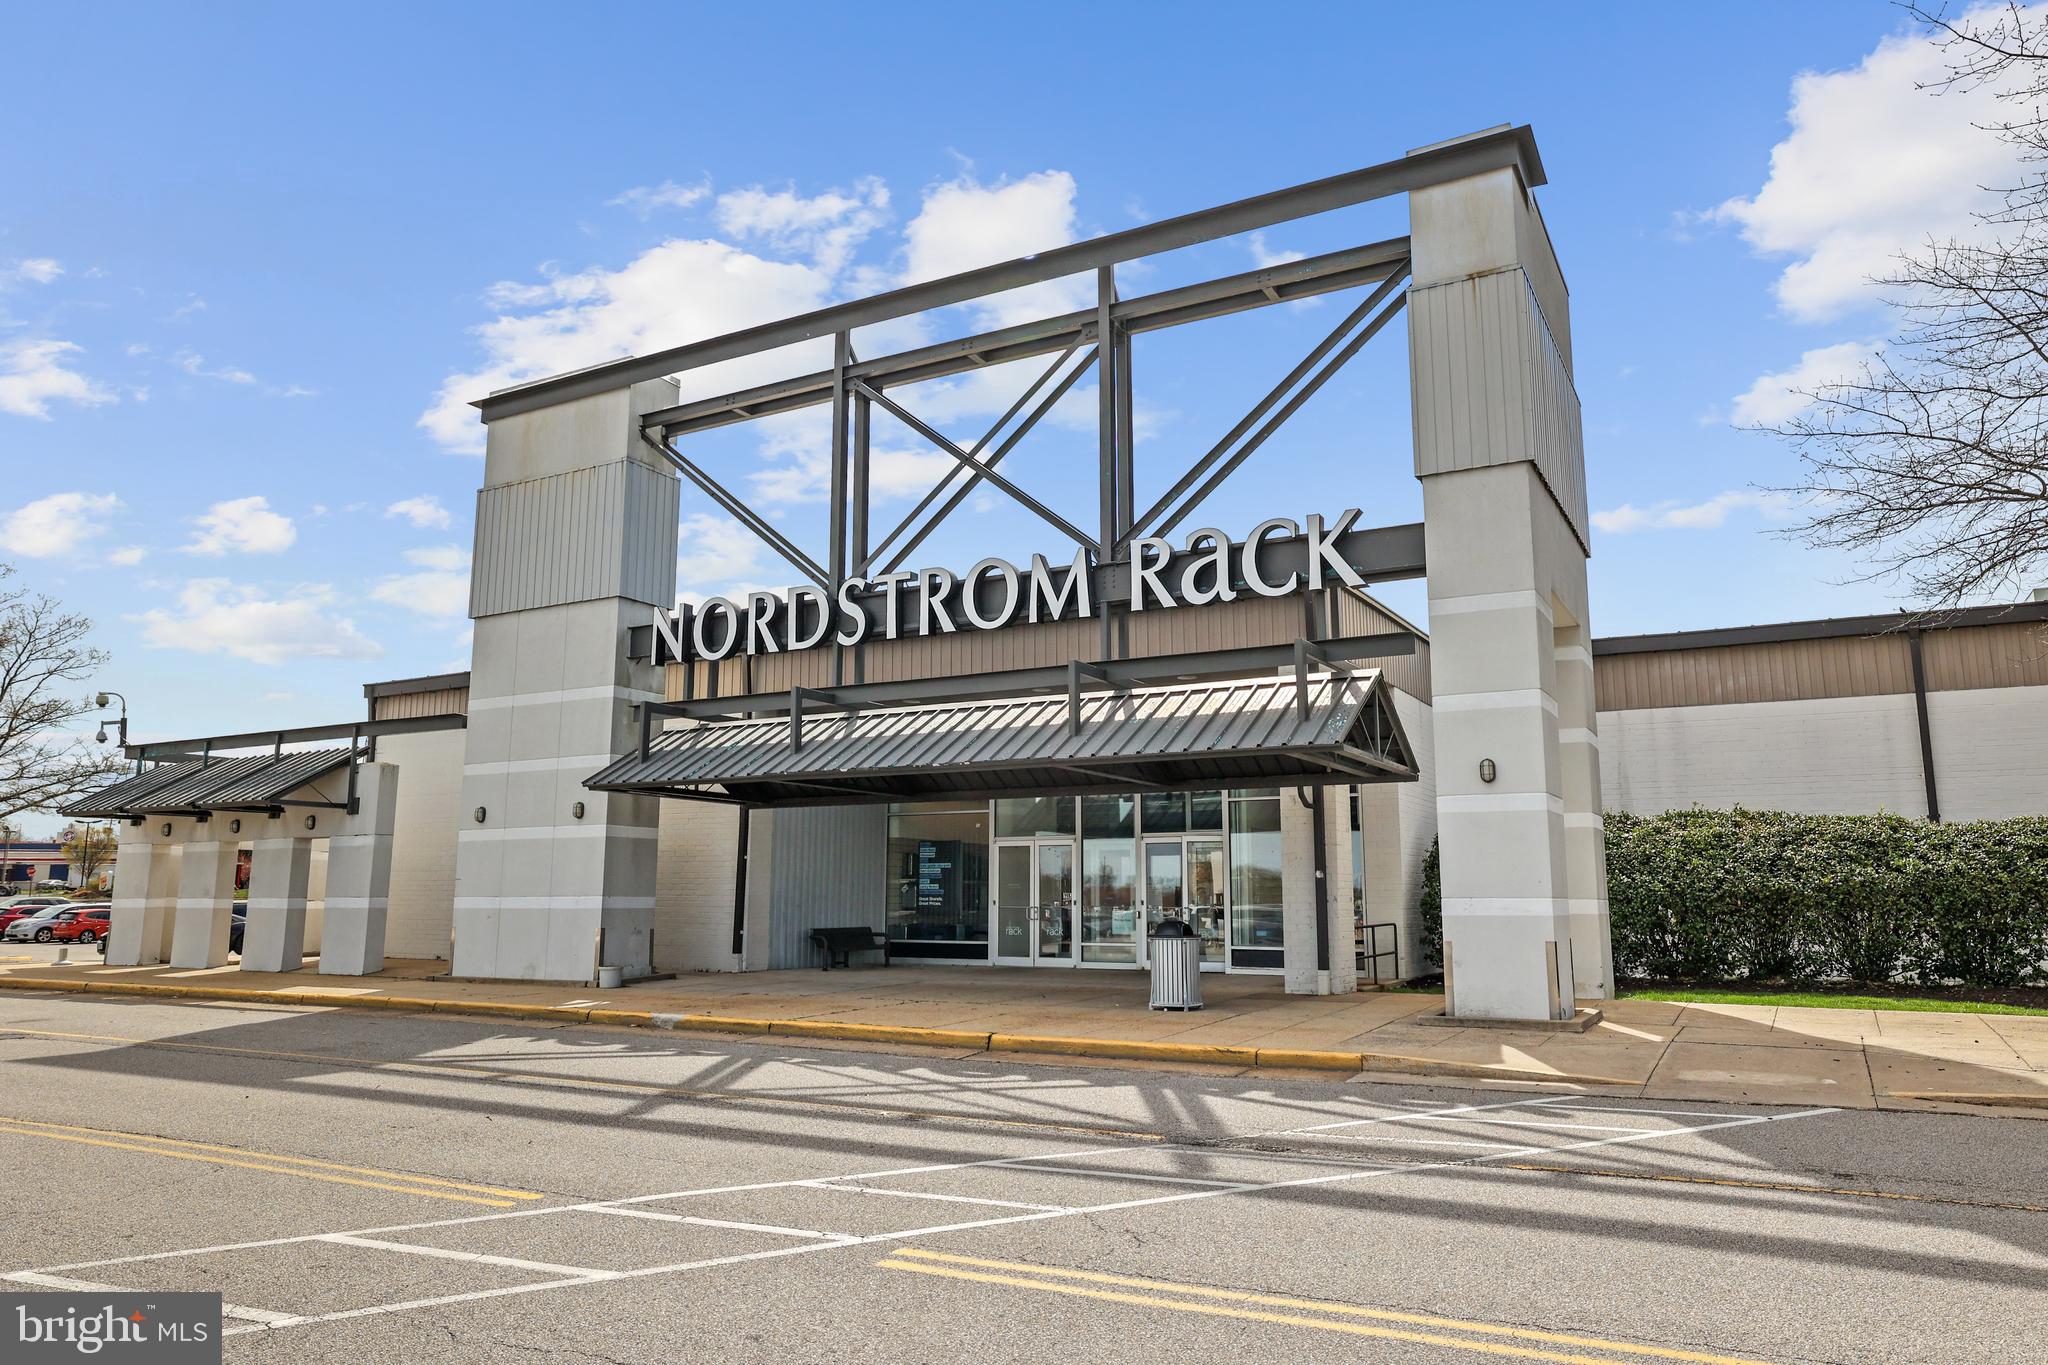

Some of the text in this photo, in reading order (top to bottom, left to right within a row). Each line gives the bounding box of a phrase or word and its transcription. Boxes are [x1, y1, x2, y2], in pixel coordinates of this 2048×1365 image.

[651, 548, 1094, 666] NORDSTROM
[1005, 926, 1023, 936] rack
[1046, 926, 1064, 937] rack
